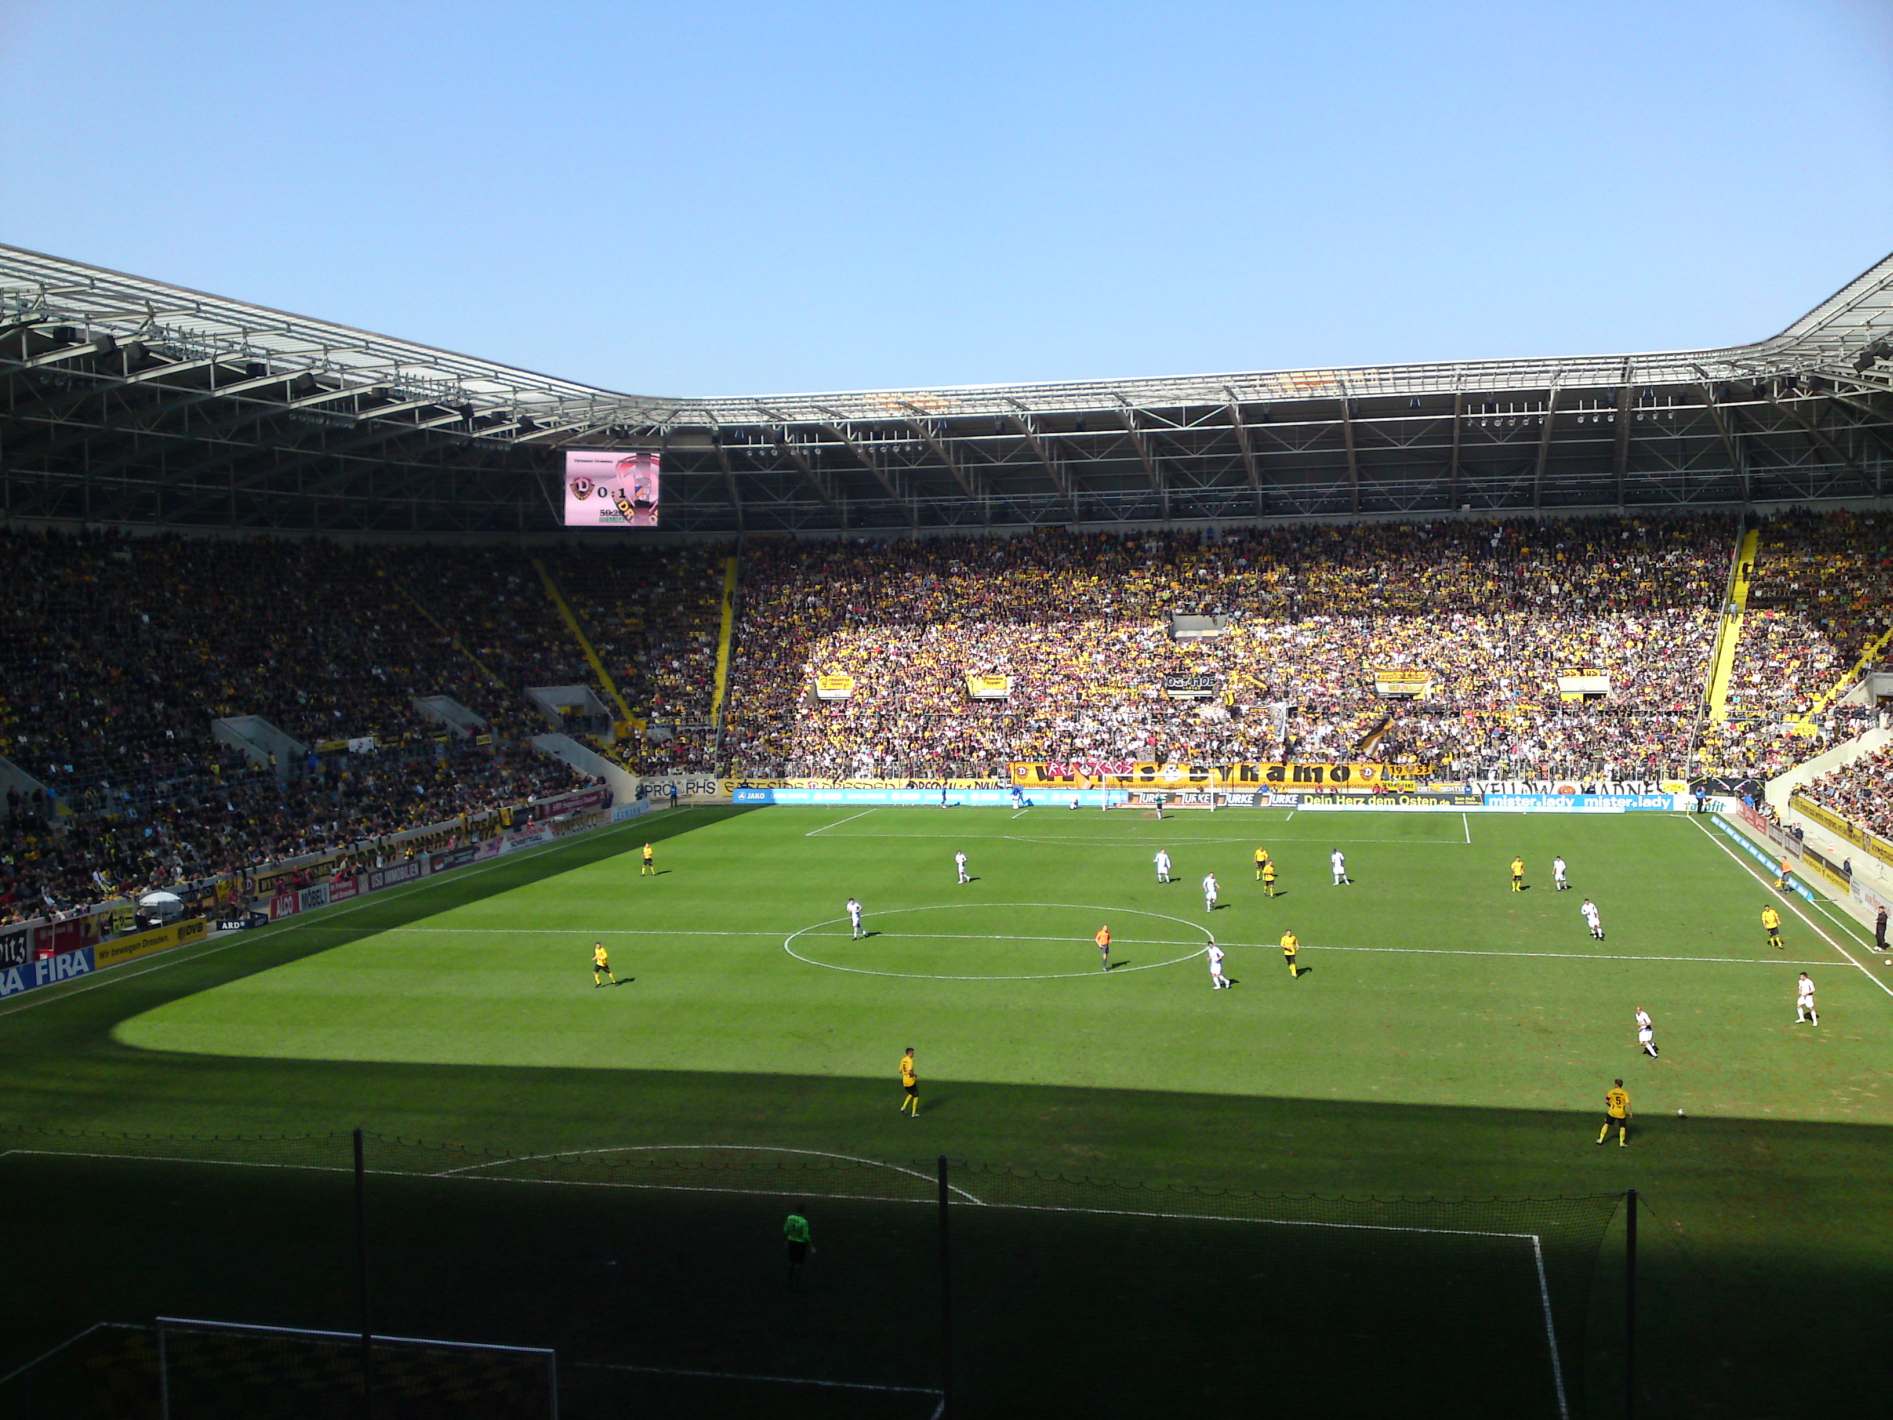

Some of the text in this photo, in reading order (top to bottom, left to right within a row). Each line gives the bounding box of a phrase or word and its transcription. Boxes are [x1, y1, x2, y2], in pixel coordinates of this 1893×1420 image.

[1390, 766, 1430, 774] 19 53
[747, 792, 765, 800] JAKO
[1304, 795, 1328, 806] Dein
[1336, 795, 1364, 807] Herz
[1368, 796, 1396, 806] dem
[221, 922, 241, 930] ARD
[35, 949, 90, 986] FIRA
[1615, 1096, 1621, 1105] 5
